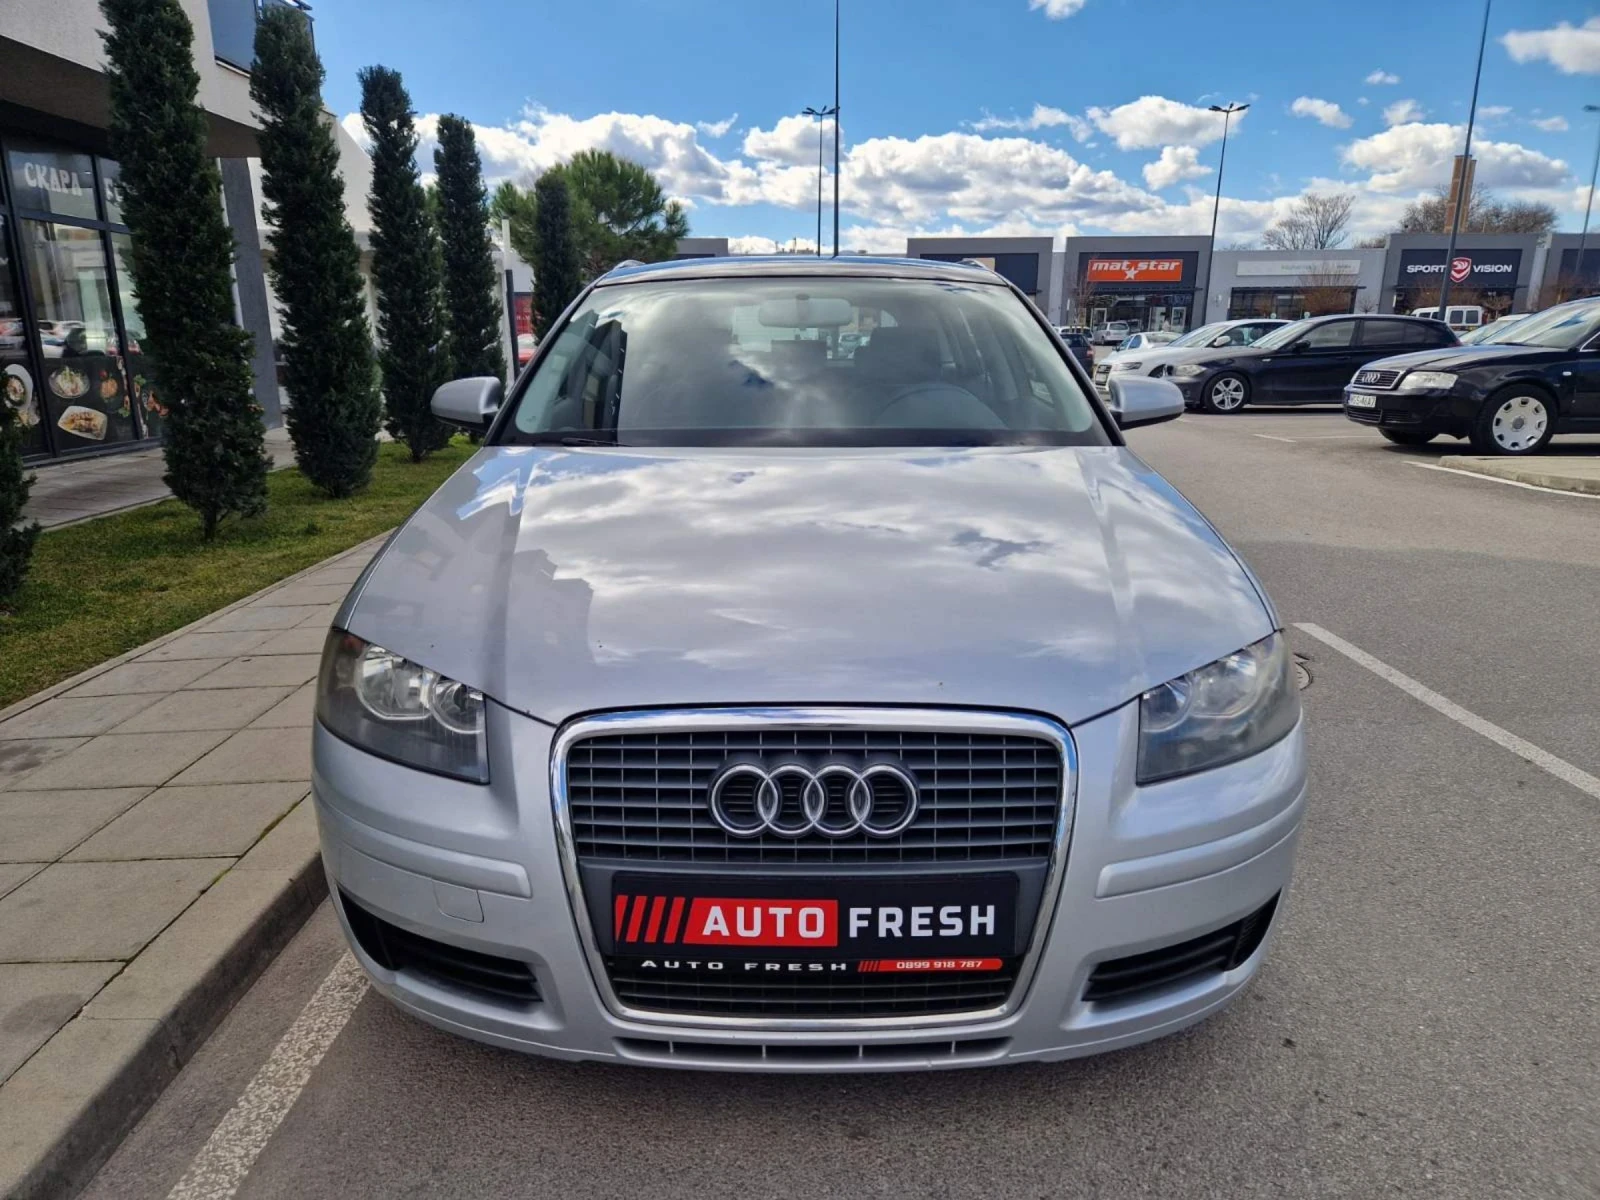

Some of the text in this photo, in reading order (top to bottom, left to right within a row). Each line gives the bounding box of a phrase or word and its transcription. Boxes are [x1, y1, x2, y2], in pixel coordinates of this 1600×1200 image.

[23, 161, 82, 197] СКАРА
[1091, 259, 1180, 271] mat star
[1406, 264, 1513, 273] SPORT VISION
[702, 904, 995, 939] AUTO FRESH
[641, 960, 983, 971] AUTO FRESH 0899 918 787
